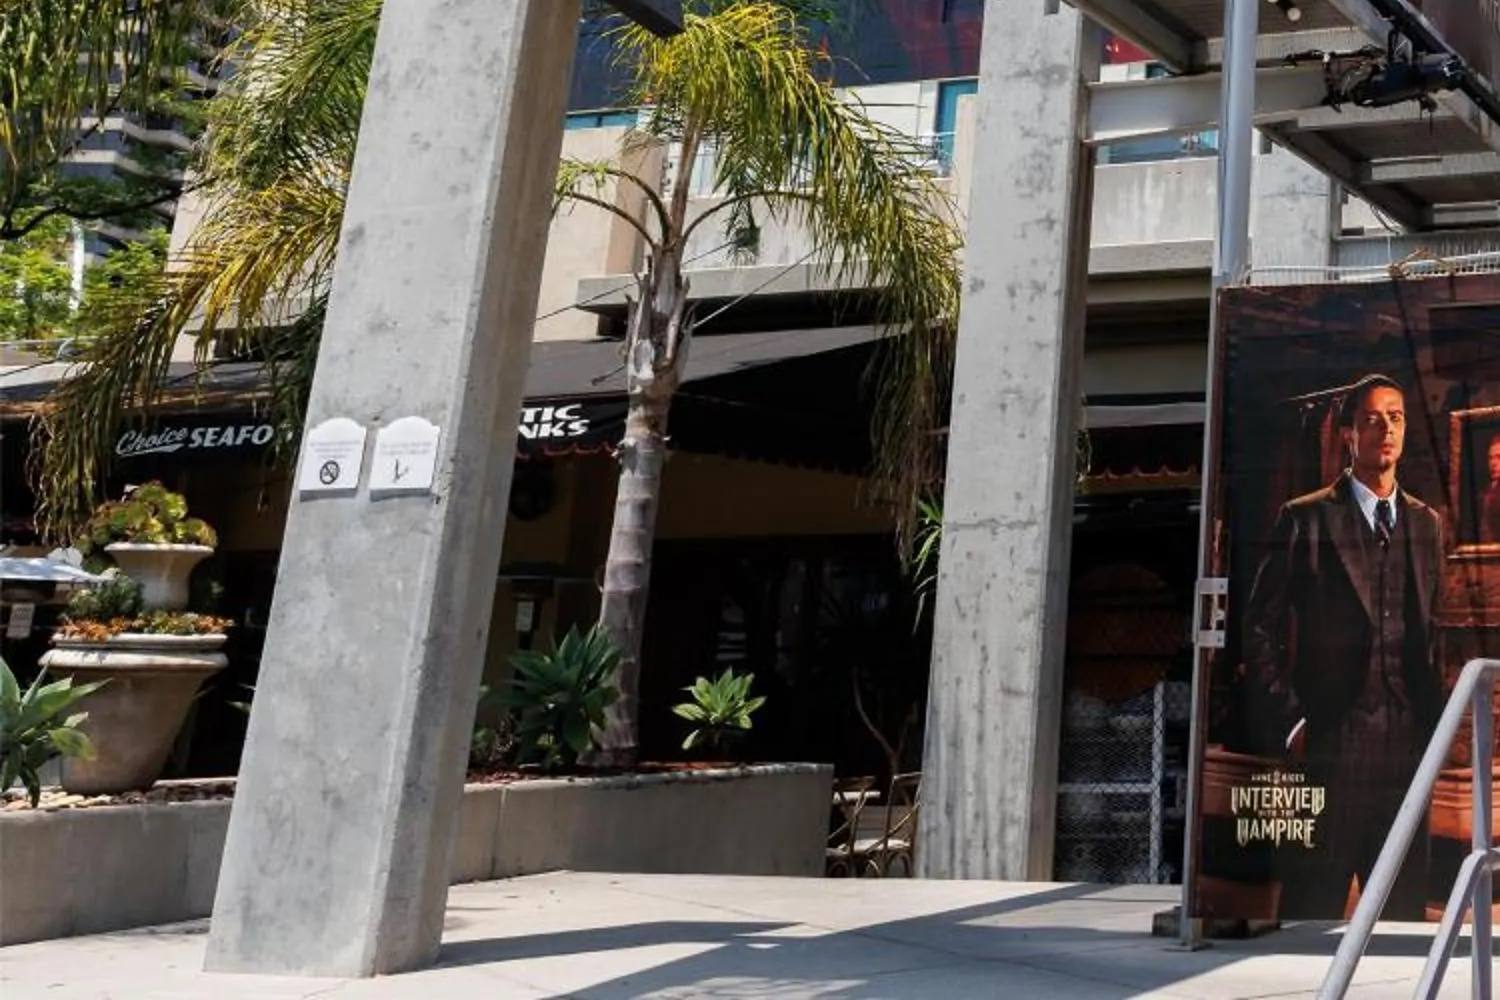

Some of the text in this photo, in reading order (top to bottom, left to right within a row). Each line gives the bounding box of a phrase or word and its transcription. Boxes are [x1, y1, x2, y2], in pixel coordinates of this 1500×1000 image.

[521, 404, 584, 422] TIC
[116, 424, 275, 456] Choice SEAFO
[1231, 786, 1325, 816] INTERVIEW
[1237, 818, 1316, 848] VAMPIRE
